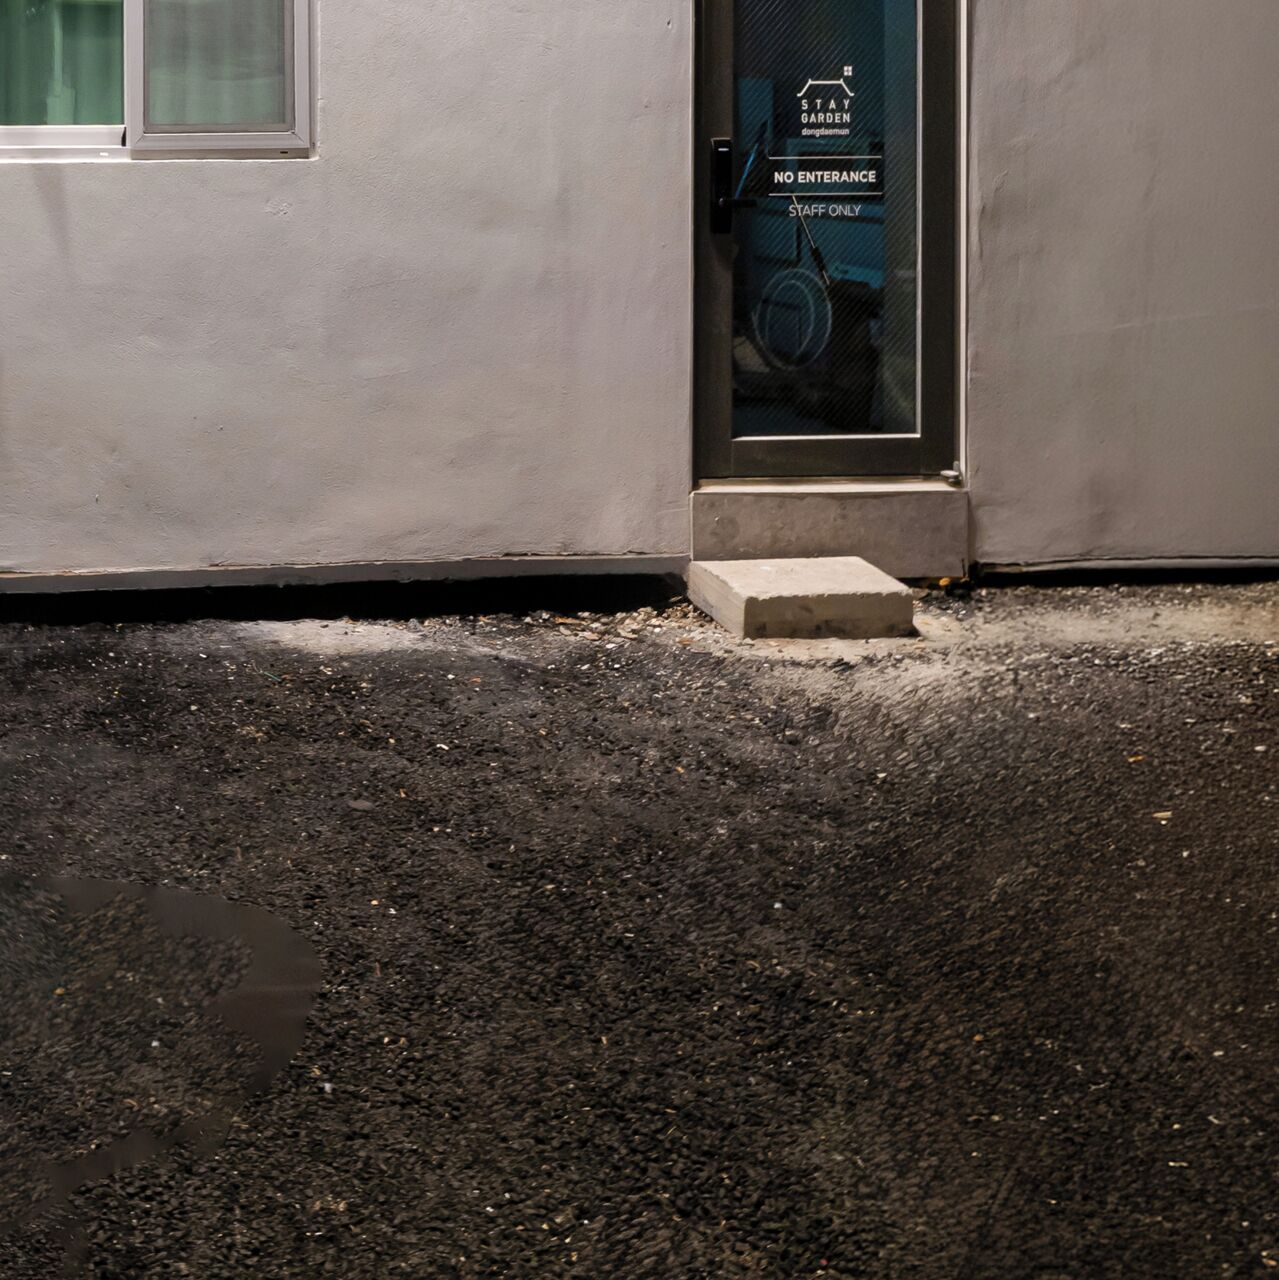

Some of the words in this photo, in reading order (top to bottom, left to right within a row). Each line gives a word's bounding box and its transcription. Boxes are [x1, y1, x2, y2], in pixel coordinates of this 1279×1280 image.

[802, 100, 850, 109] STAY
[801, 113, 851, 123] GARDEN
[801, 128, 850, 137] dongdaemun
[774, 172, 794, 183] NO
[798, 171, 876, 182] ENTERANCE
[789, 205, 826, 216] STAFF
[829, 205, 861, 216] ONLY
